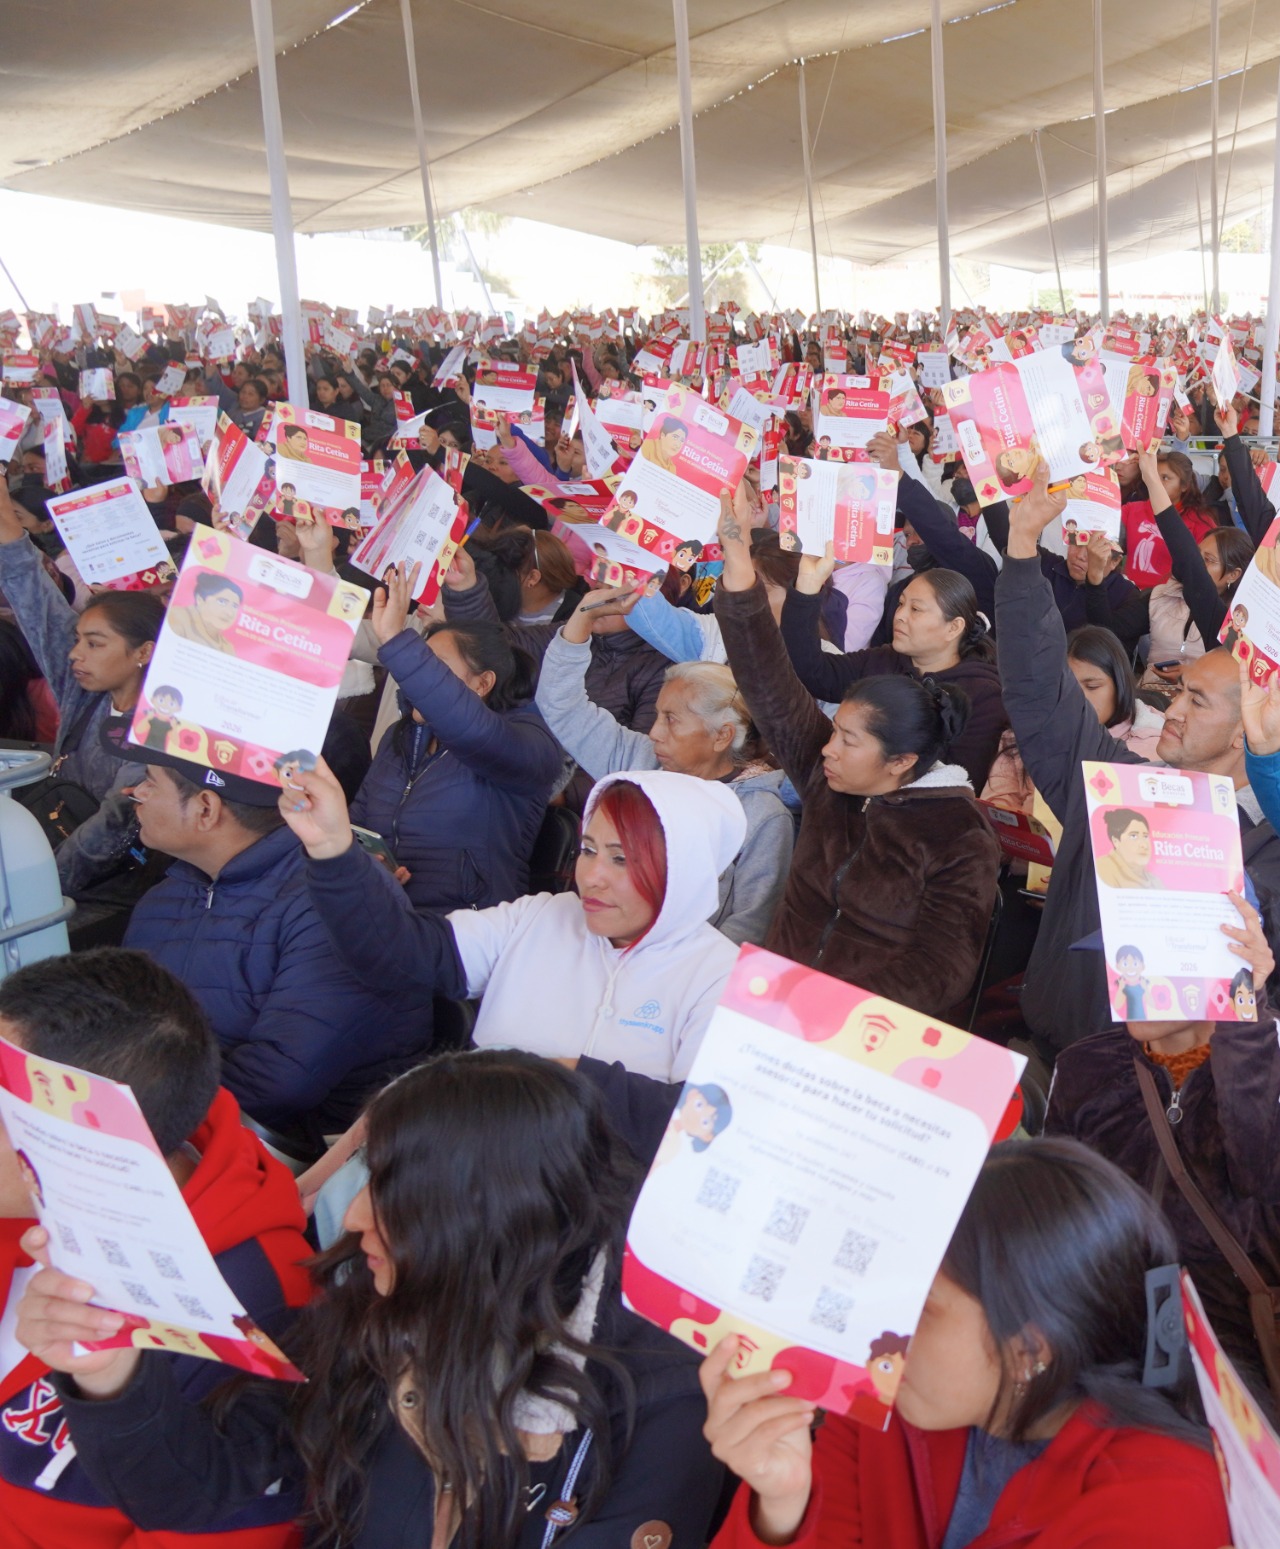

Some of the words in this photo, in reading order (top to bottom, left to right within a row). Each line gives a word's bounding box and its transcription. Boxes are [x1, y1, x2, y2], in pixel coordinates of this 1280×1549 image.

[859, 401, 879, 409] Cetina
[993, 386, 1009, 423] Cetina
[1138, 396, 1146, 412] Rita
[1004, 423, 1017, 448] Rita
[1134, 413, 1144, 437] Cetina
[309, 442, 325, 452] Rita
[325, 446, 349, 459] Cetina
[681, 446, 700, 460] Rita
[701, 456, 729, 478] Cetina
[851, 501, 860, 518] Rita
[849, 519, 859, 547] Cetina
[238, 612, 271, 638] Rita
[272, 626, 322, 656] Cetina
[1264, 643, 1279, 658] 2026
[1161, 781, 1186, 793] Becas
[1154, 840, 1182, 857] Rita
[1183, 842, 1224, 861] Cetina
[1180, 962, 1198, 972] 2026
[754, 1063, 802, 1089] asesoría
[802, 1083, 830, 1102] para
[831, 1094, 864, 1115] hacer
[865, 1108, 878, 1122] tu
[878, 1114, 934, 1145] solicitud?
[781, 1060, 817, 1083] dudas
[818, 1075, 852, 1096] sobre
[852, 1089, 865, 1101] la
[864, 1093, 893, 1114] beca
[901, 1110, 953, 1140] necesitas
